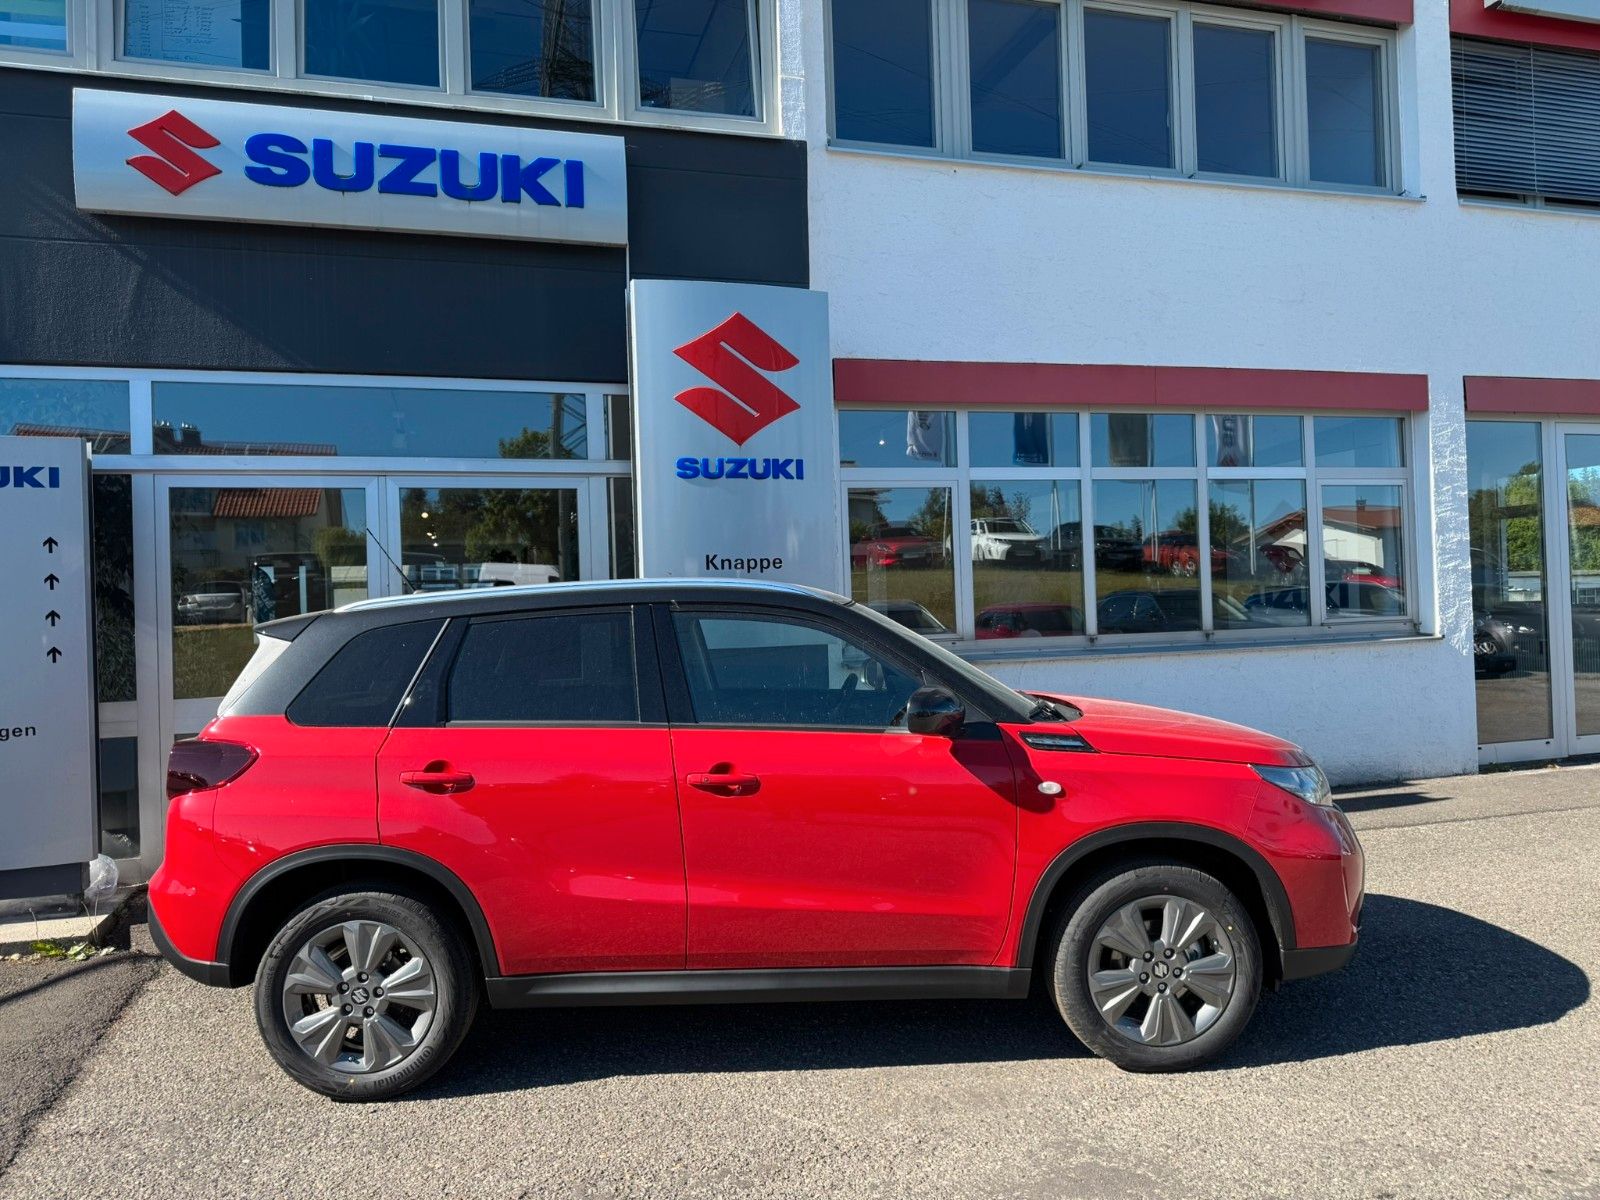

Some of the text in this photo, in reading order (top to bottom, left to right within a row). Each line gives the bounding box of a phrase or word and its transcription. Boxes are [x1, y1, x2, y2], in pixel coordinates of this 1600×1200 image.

[244, 132, 584, 208] SUZUKI
[676, 457, 804, 480] SUZUKI
[705, 554, 783, 573] Knappe
[373, 1046, 434, 1088] Continental
